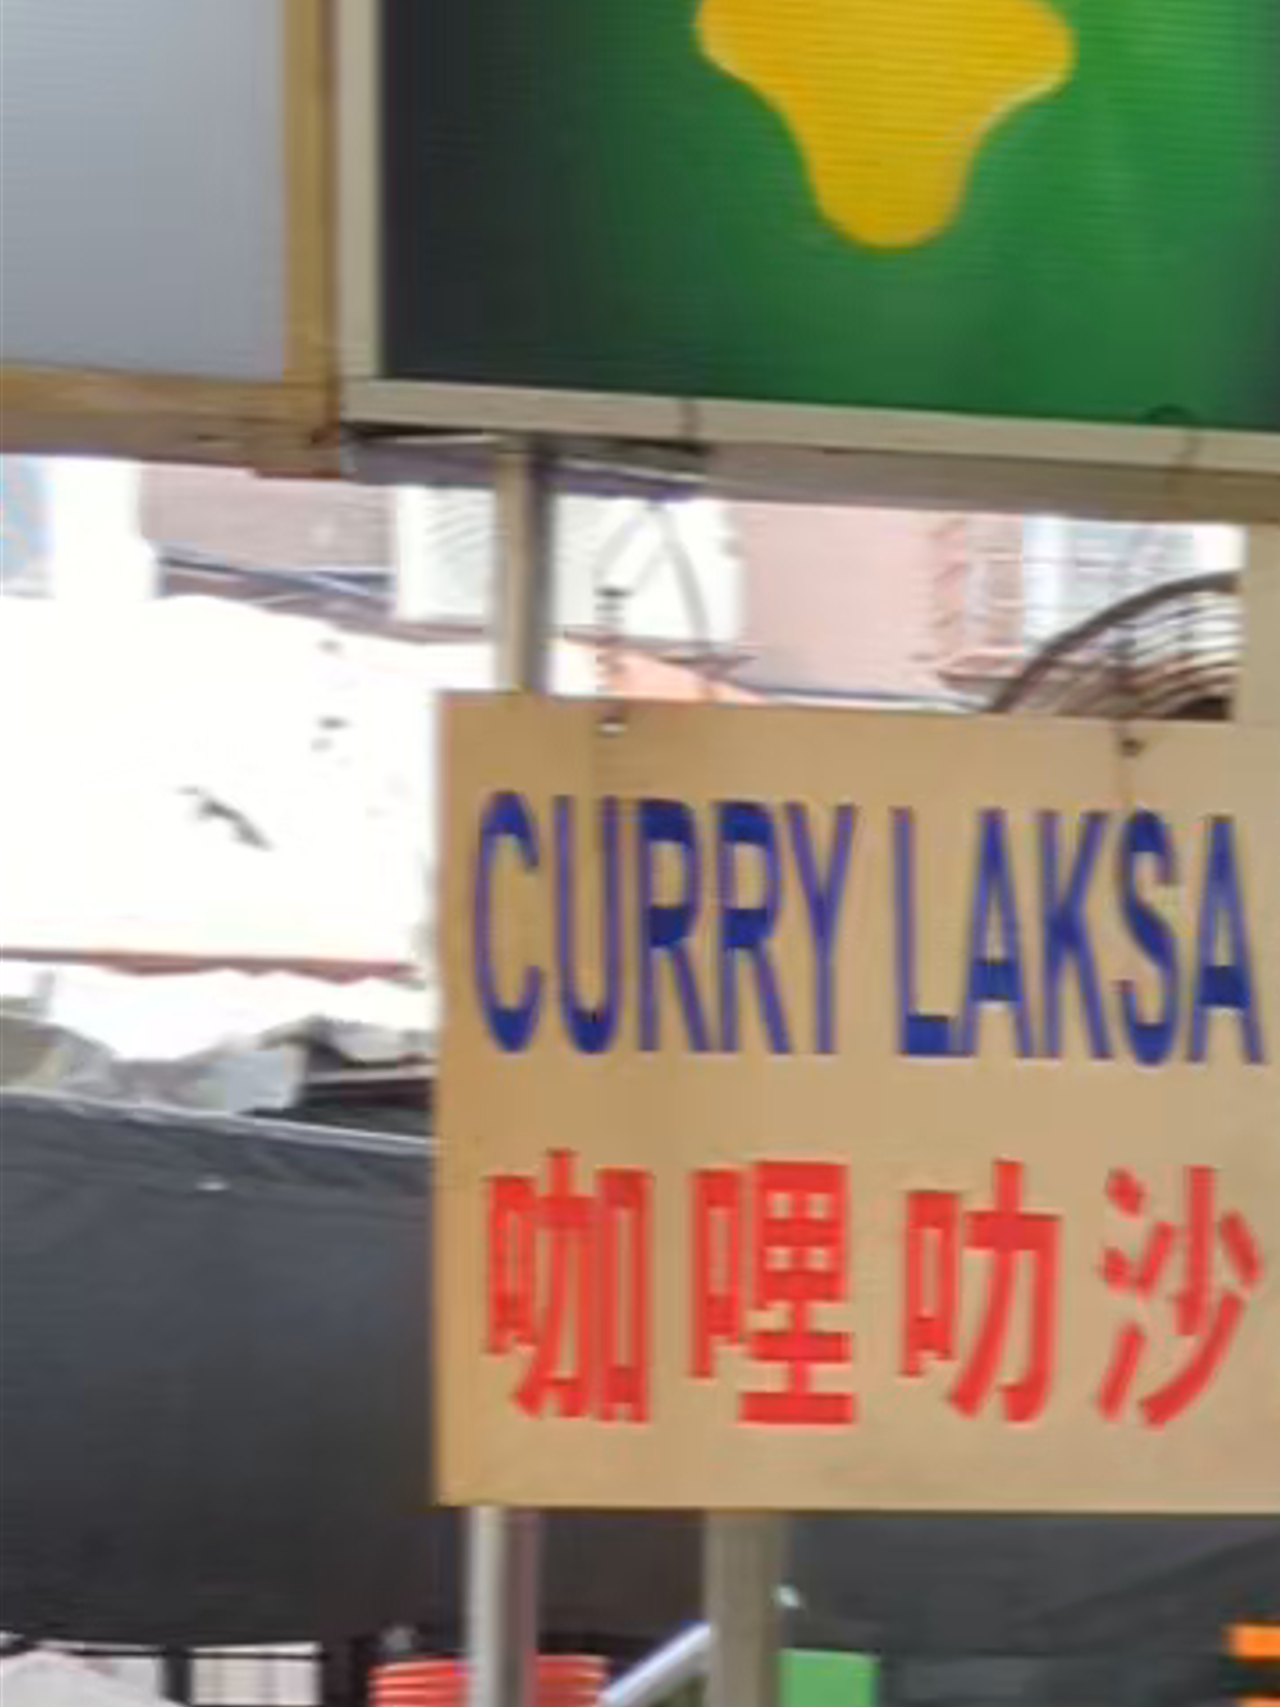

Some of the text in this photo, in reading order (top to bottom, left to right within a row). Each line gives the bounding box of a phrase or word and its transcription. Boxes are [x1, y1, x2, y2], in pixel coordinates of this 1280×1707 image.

[474, 789, 1267, 1066] CURRY LAKSA
[480, 1146, 1268, 1437] 咖哩叻沙
